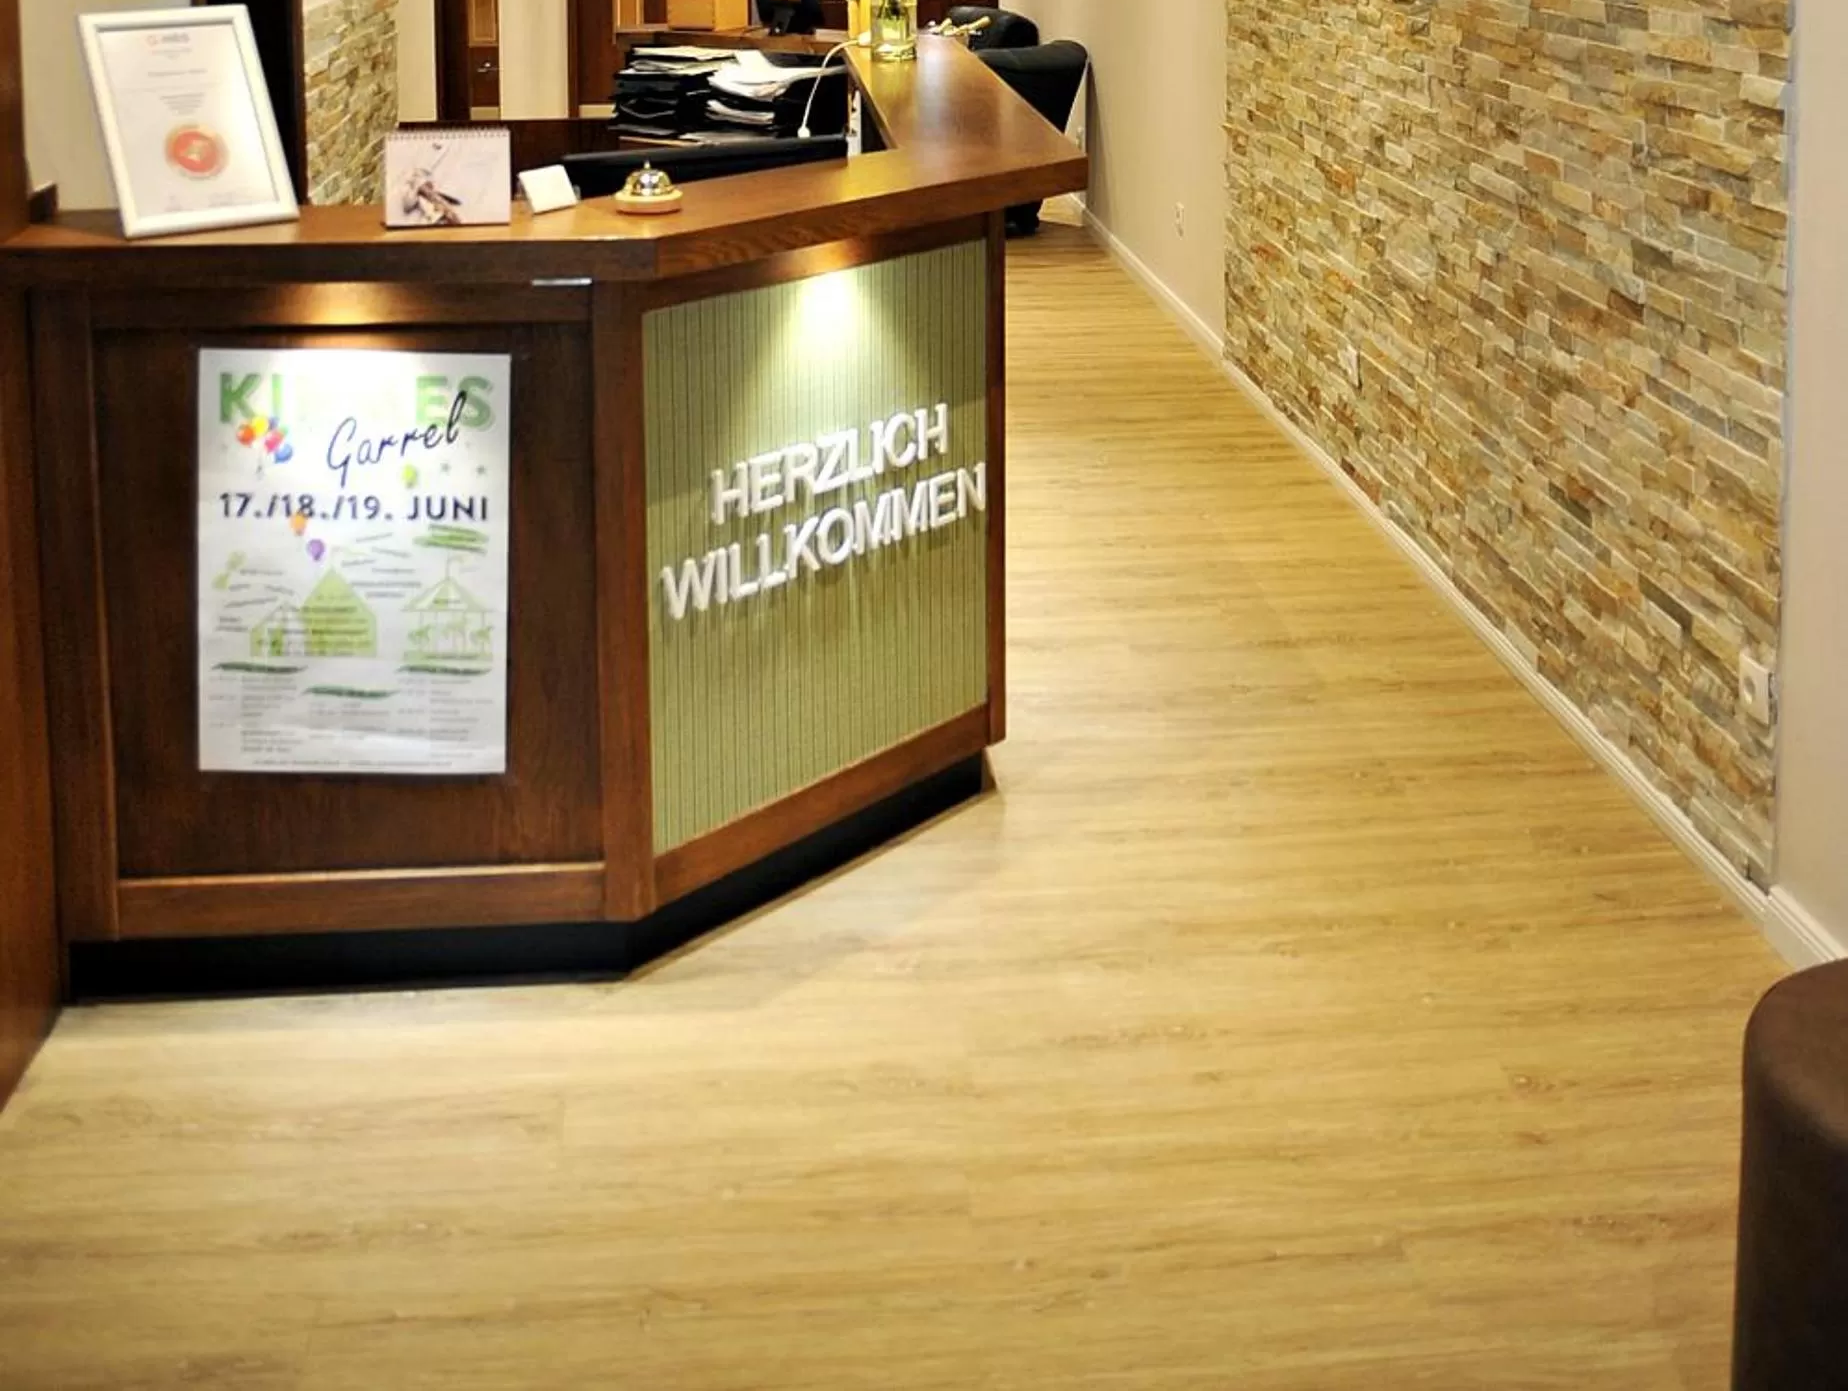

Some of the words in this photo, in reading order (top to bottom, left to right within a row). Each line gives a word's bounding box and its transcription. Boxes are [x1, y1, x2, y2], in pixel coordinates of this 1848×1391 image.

[219, 372, 493, 429] KIES
[326, 389, 468, 488] Garrel
[219, 492, 393, 521] 17./18./19.
[406, 496, 488, 521] JUNI
[711, 403, 948, 525] HERZLICH
[660, 461, 987, 621] WILLKOMMEN
